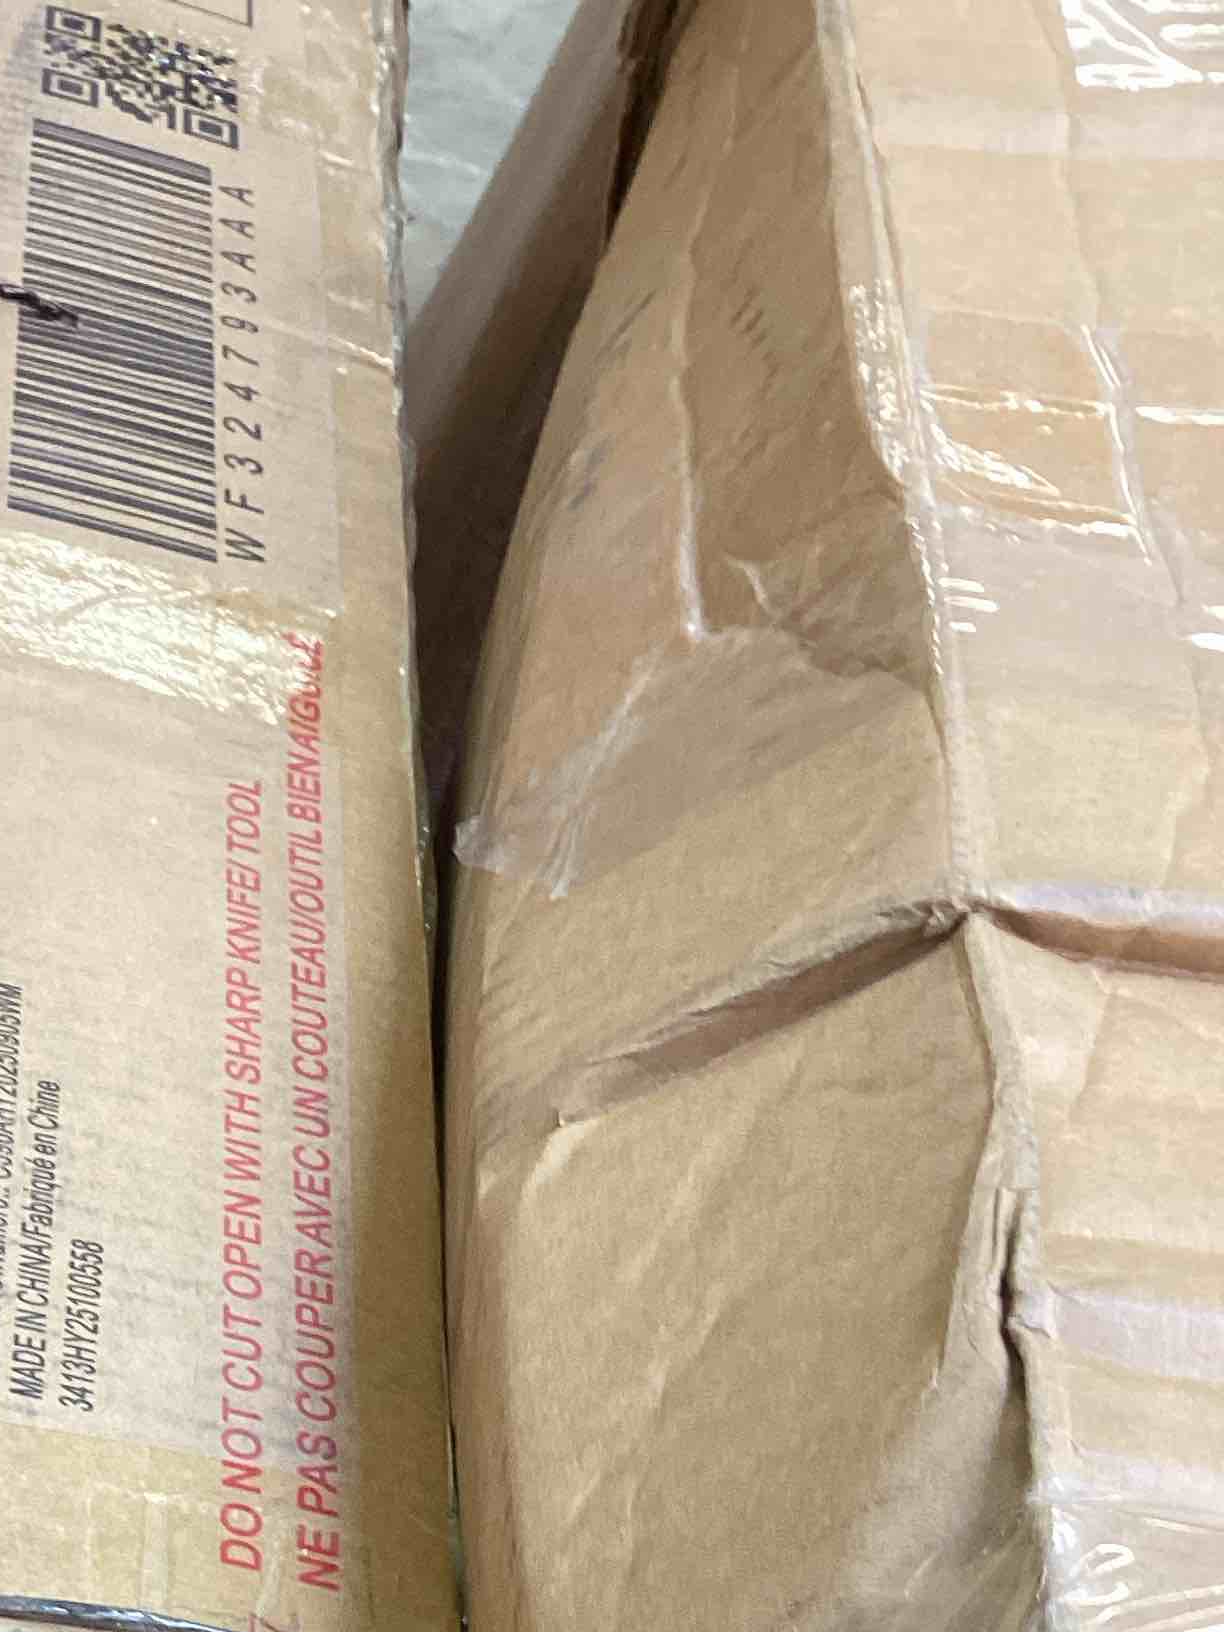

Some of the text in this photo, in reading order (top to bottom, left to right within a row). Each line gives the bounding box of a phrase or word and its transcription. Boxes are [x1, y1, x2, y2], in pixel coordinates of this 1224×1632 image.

[285, 750, 324, 825] BIEN
[287, 830, 330, 1082] COUTEAU/OUTIL
[219, 778, 264, 1572] DO NOT CUT OPEN WITH SHARP KNIFE/ TOOL
[291, 1085, 332, 1139] UN
[8, 1080, 63, 1400] MADE IN CHINA/Fabriqué en Chine
[291, 1144, 334, 1250] AVEC
[58, 1238, 105, 1412] 3413HY25100558
[293, 1247, 338, 1422] COUPER
[295, 1430, 340, 1518] PAS
[295, 1524, 343, 1593] NE
